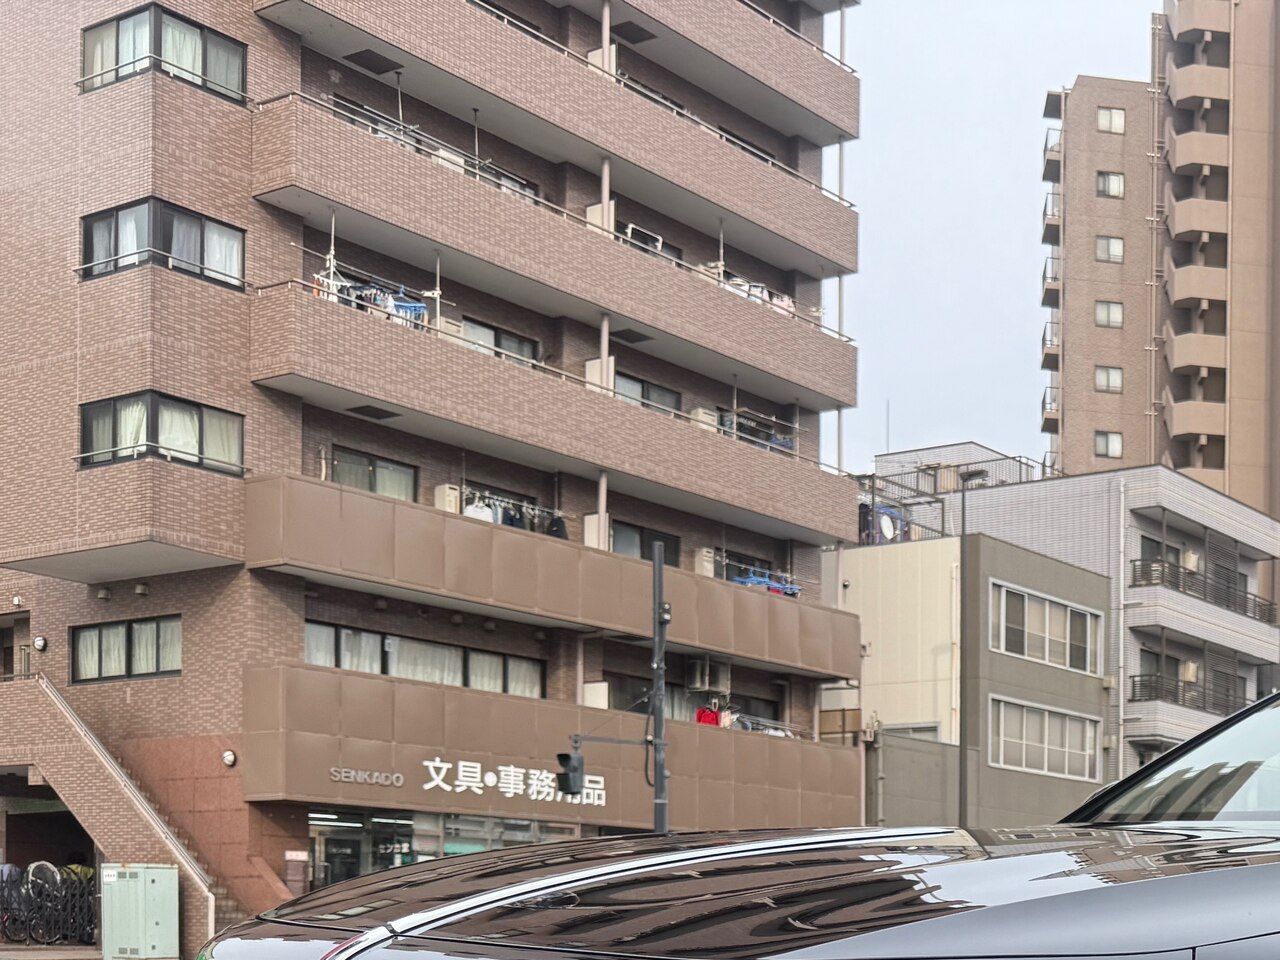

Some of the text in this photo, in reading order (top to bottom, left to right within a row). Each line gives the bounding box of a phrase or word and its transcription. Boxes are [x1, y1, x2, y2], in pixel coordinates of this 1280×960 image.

[329, 766, 405, 788] SENKADO
[422, 756, 607, 807] 文具・事務品
